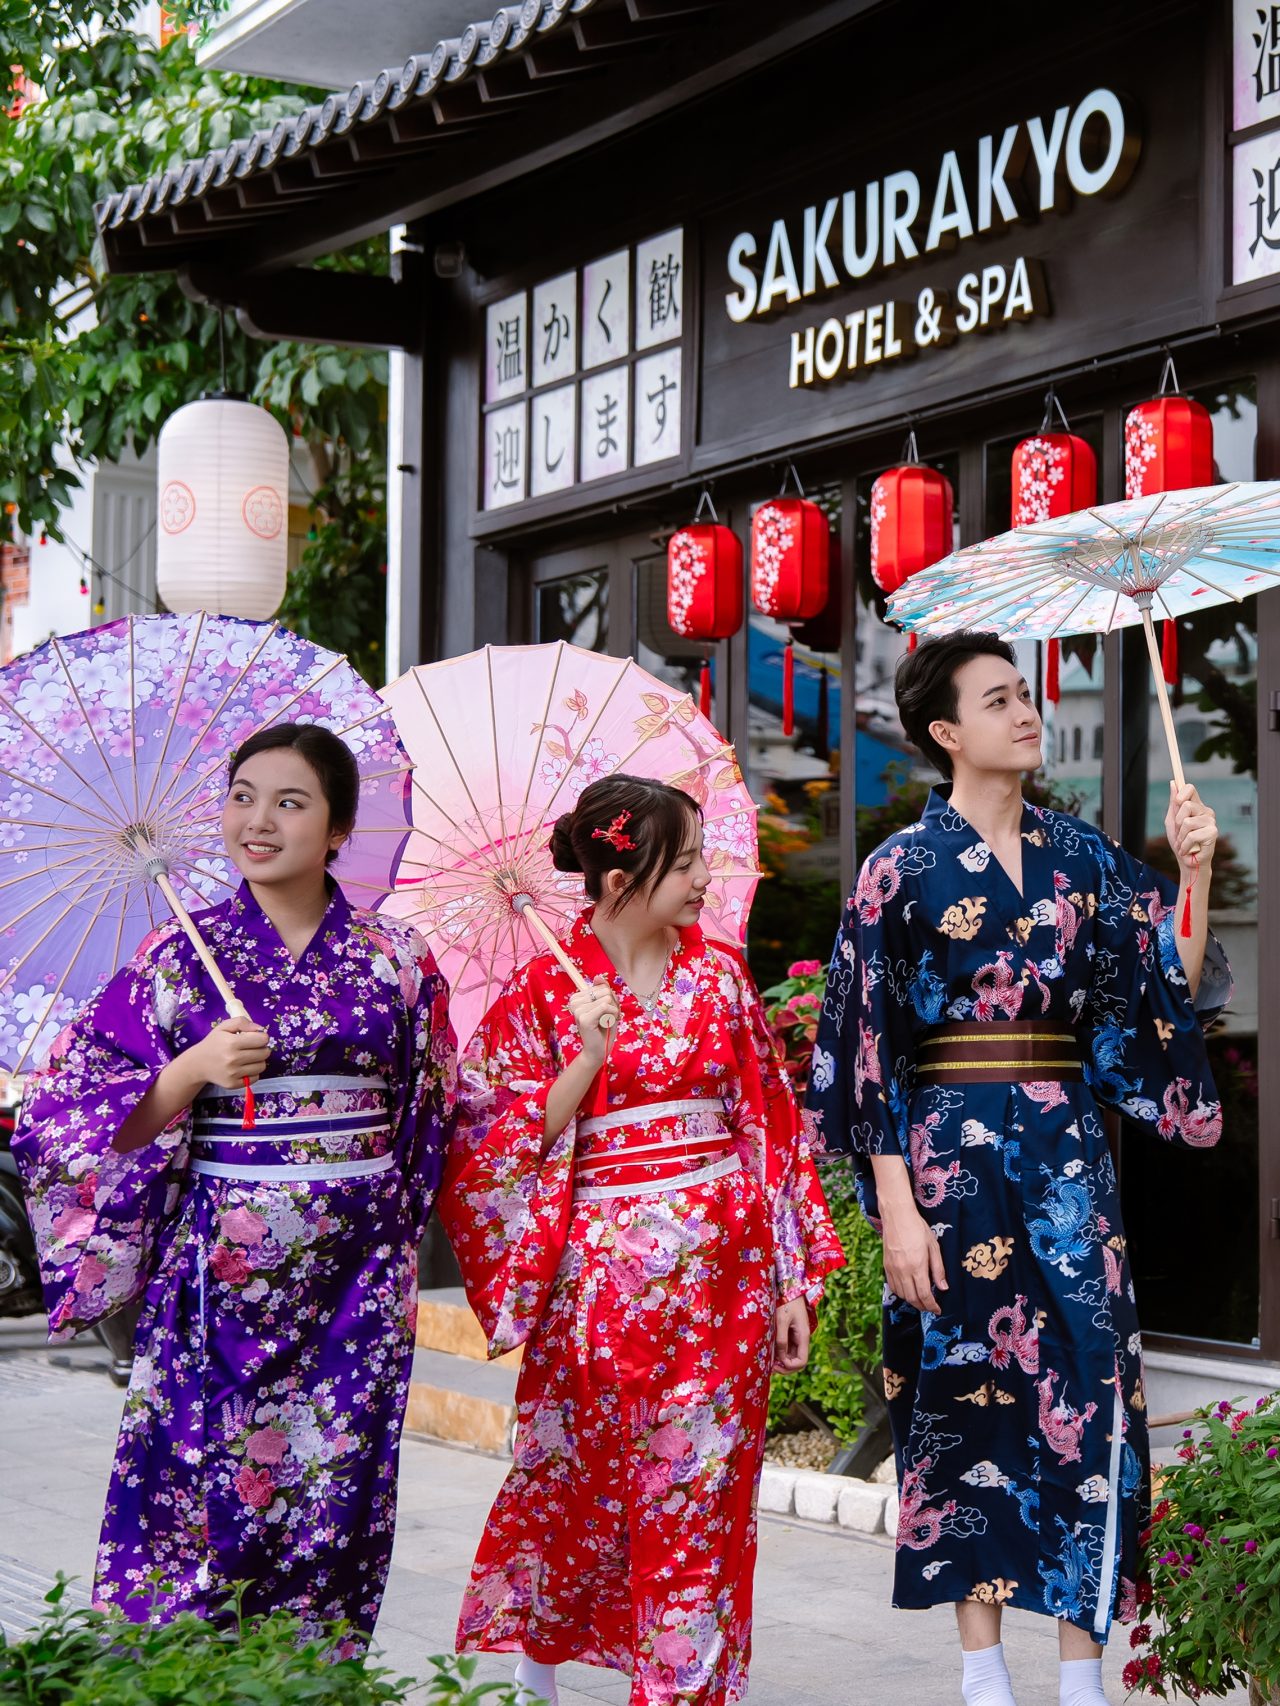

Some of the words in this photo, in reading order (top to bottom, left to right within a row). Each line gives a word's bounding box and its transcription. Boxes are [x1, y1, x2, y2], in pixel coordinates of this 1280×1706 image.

[726, 88, 1125, 323] SAKURAKYO
[789, 301, 902, 389] HOTEL
[914, 287, 942, 347] &
[955, 257, 1033, 334] SPA
